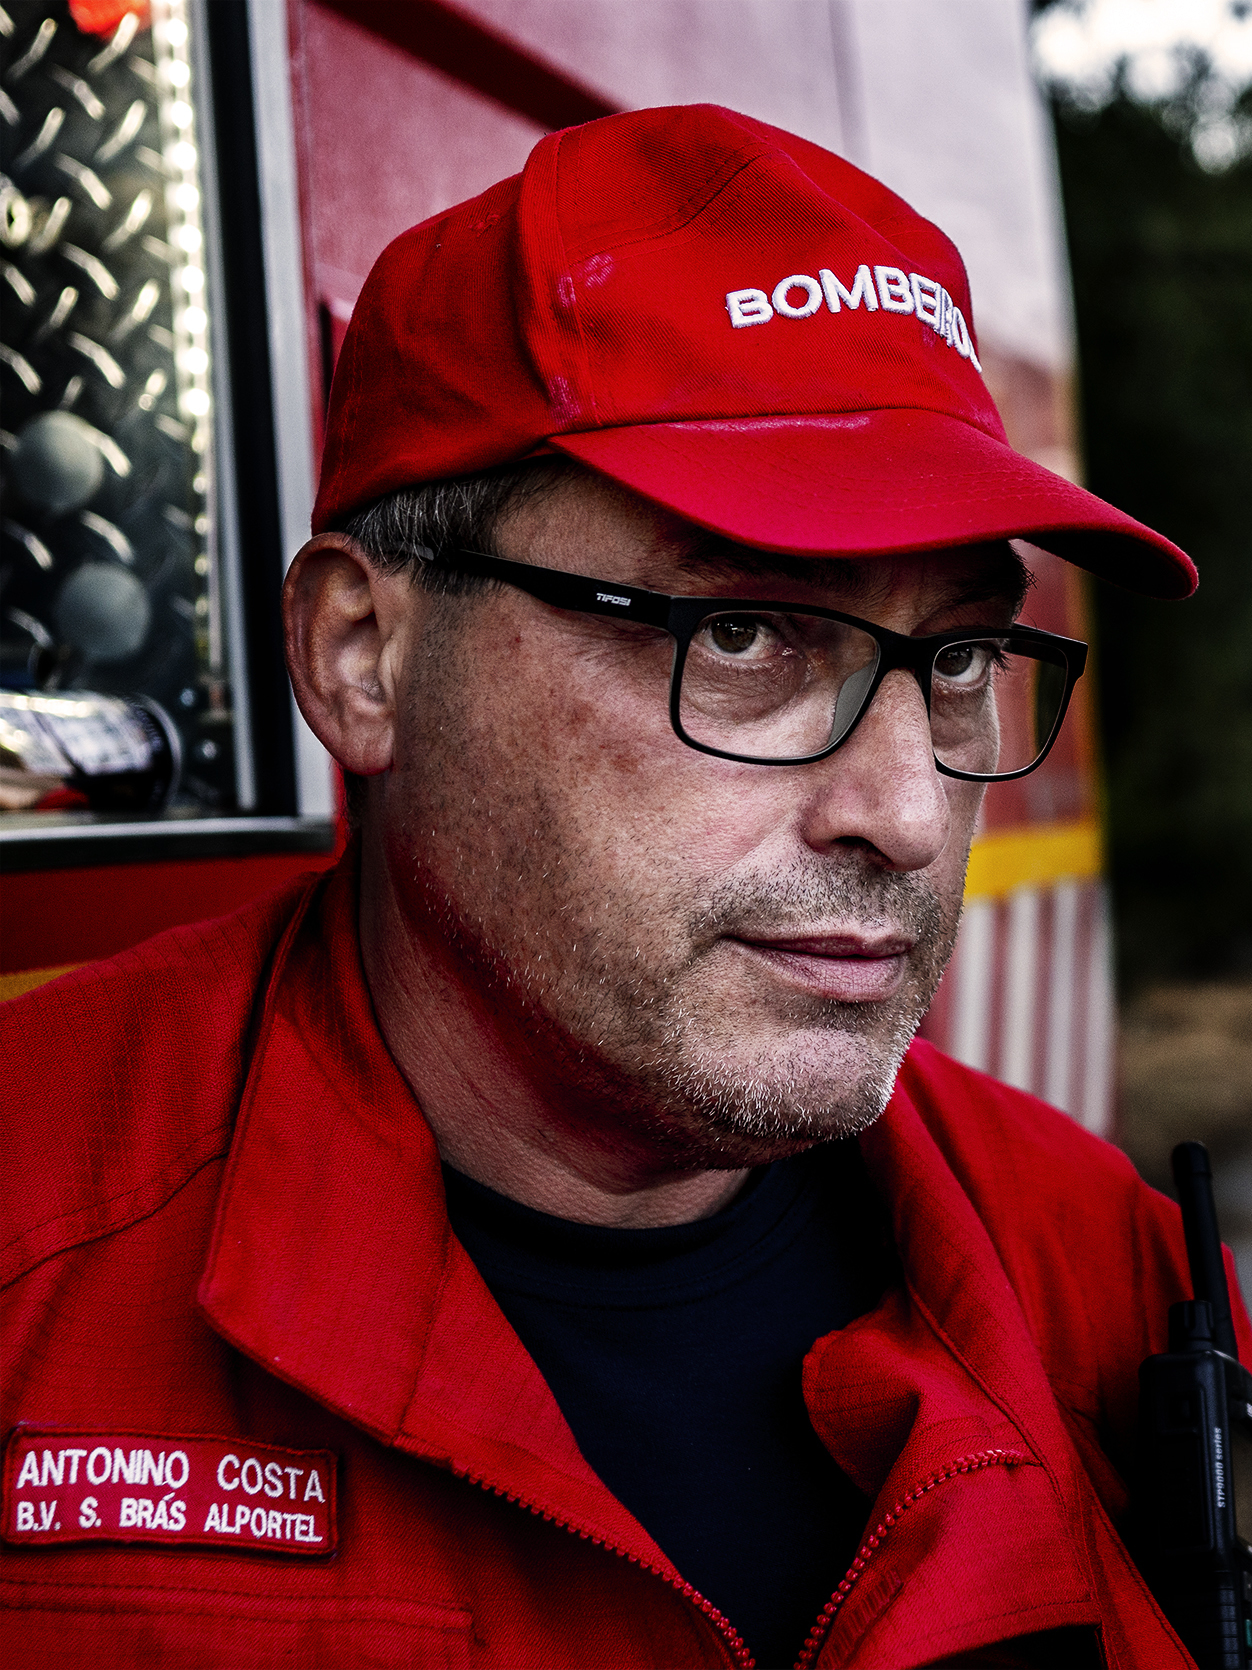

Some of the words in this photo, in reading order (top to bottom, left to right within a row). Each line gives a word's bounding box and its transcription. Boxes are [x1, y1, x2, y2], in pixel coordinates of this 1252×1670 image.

[725, 264, 982, 373] BOMBEIRO
[596, 592, 631, 607] TIFOSI
[1213, 1426, 1223, 1460] series
[16, 1447, 190, 1489] ANTONINO
[217, 1454, 325, 1503] COSTA
[1215, 1461, 1226, 1508] STP9000
[16, 1500, 61, 1531] B.V.
[79, 1496, 102, 1527] S.
[119, 1492, 187, 1531] BRÁS
[203, 1503, 323, 1542] ALPORTEL
